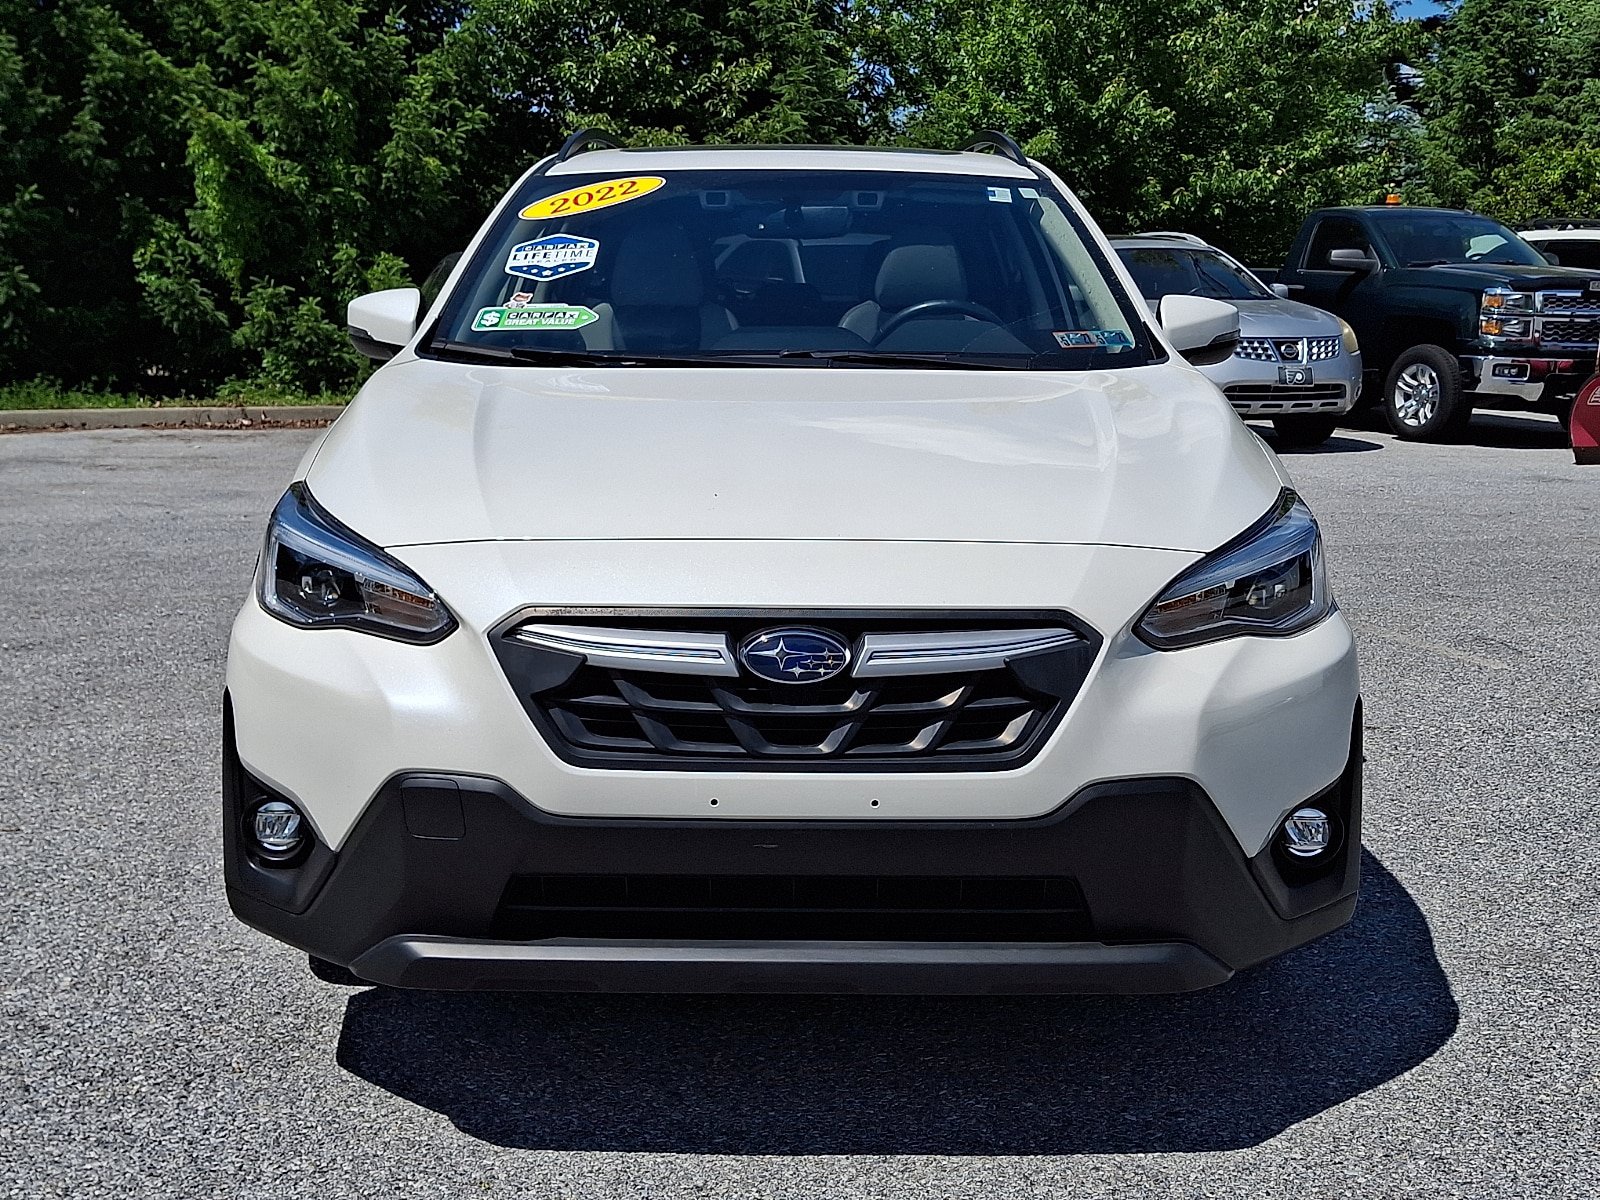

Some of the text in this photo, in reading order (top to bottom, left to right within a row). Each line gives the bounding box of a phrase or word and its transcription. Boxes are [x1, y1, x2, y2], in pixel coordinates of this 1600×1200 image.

[549, 180, 640, 215] 2022
[521, 242, 590, 252] CARFAX
[512, 250, 594, 261] LIFETIME
[506, 311, 580, 319] CARFAX
